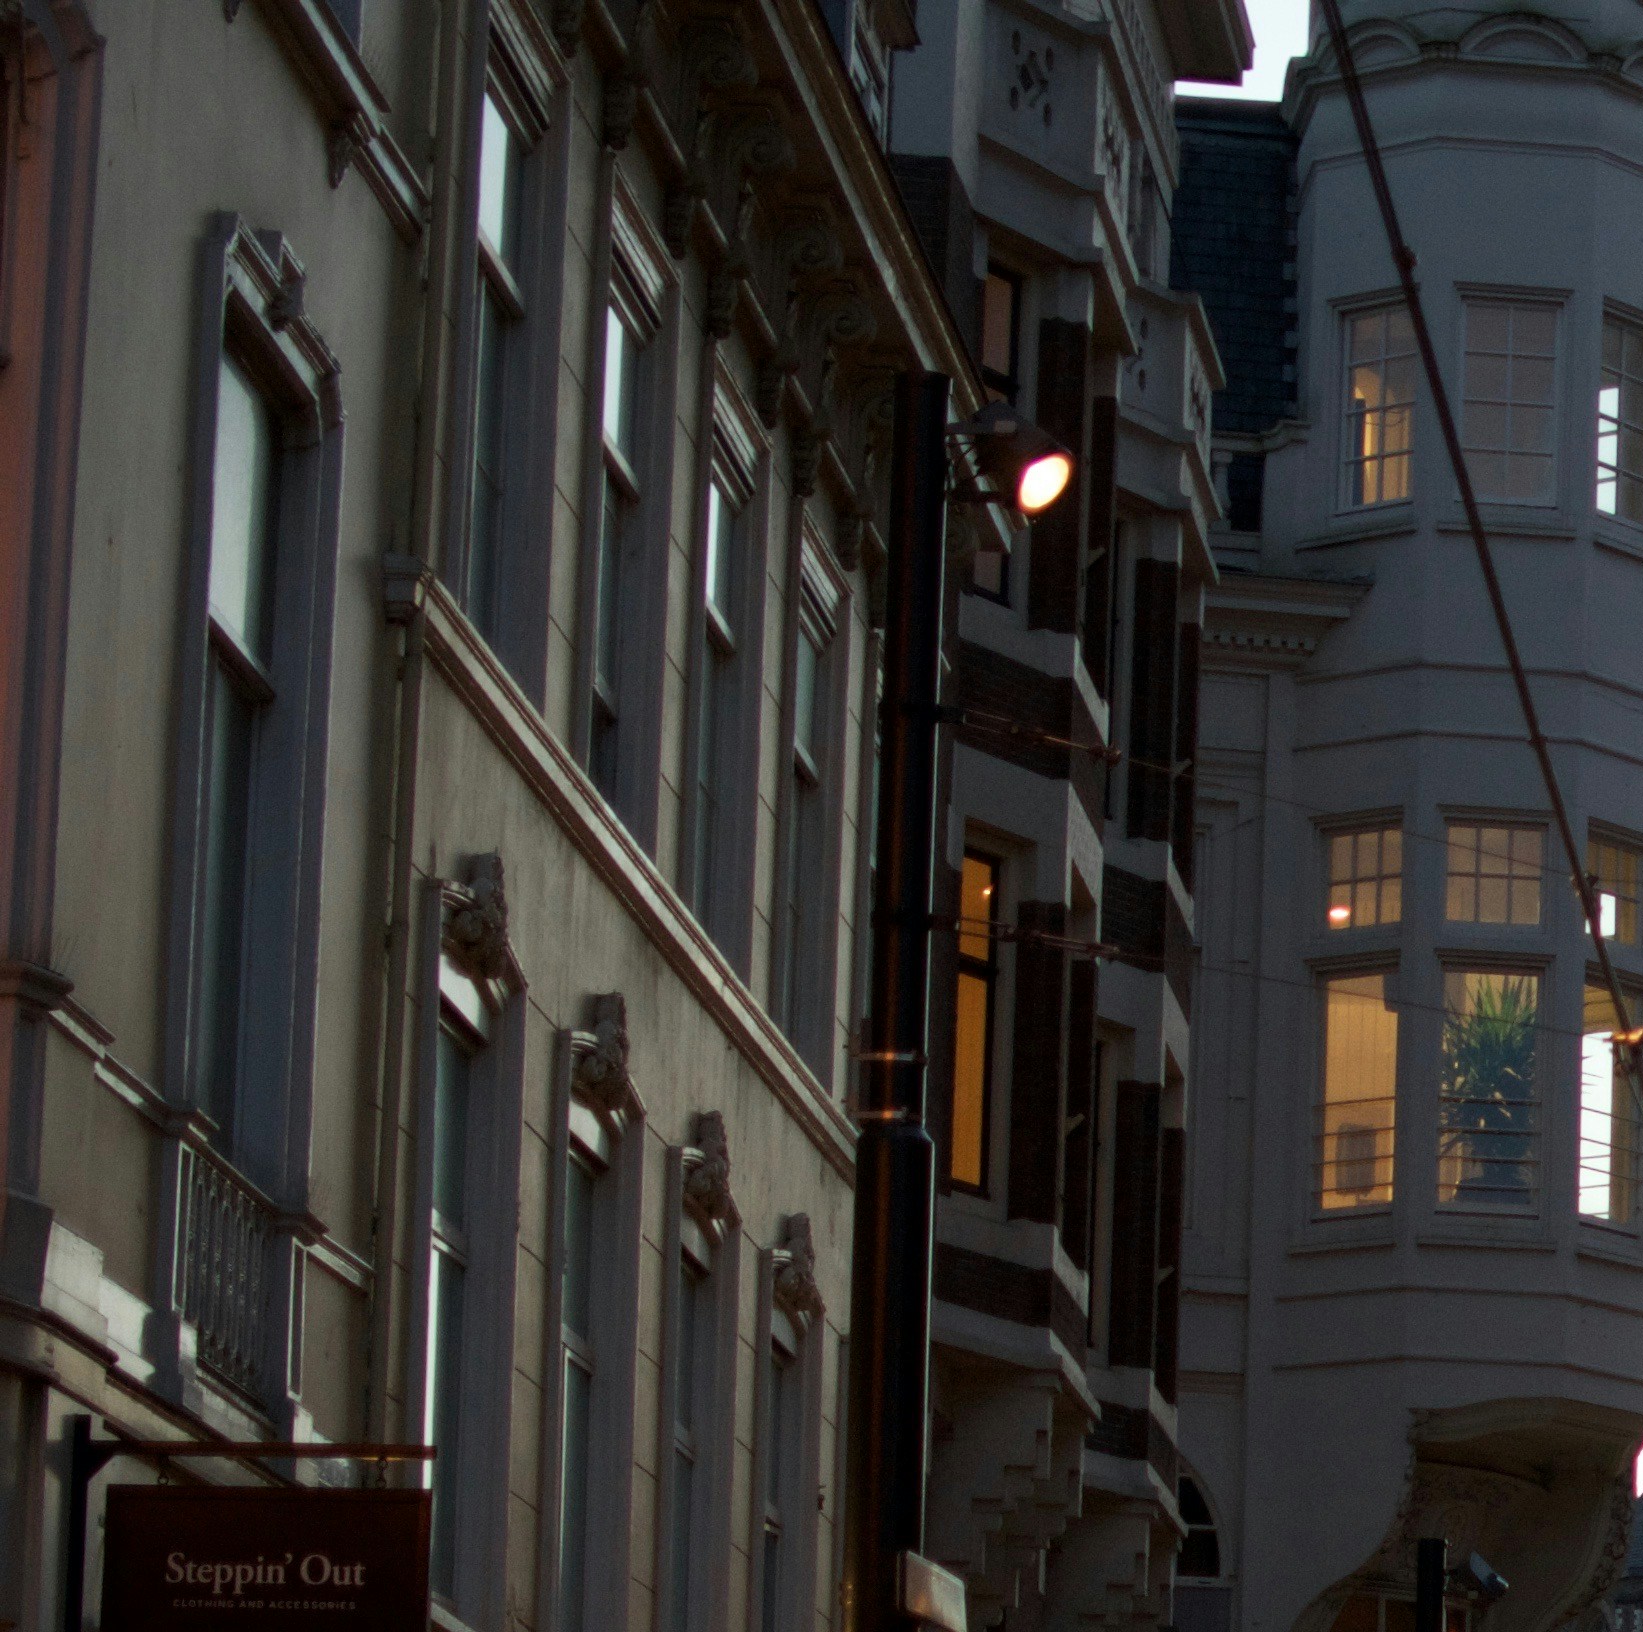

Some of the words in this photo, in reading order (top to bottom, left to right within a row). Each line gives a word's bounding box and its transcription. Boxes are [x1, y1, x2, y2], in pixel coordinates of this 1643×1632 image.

[164, 1551, 293, 1595] Steppin'
[299, 1553, 367, 1586] Out
[172, 1599, 235, 1609] CLOTHING
[238, 1600, 264, 1609] AND
[268, 1600, 356, 1611] ACCESSORIES
